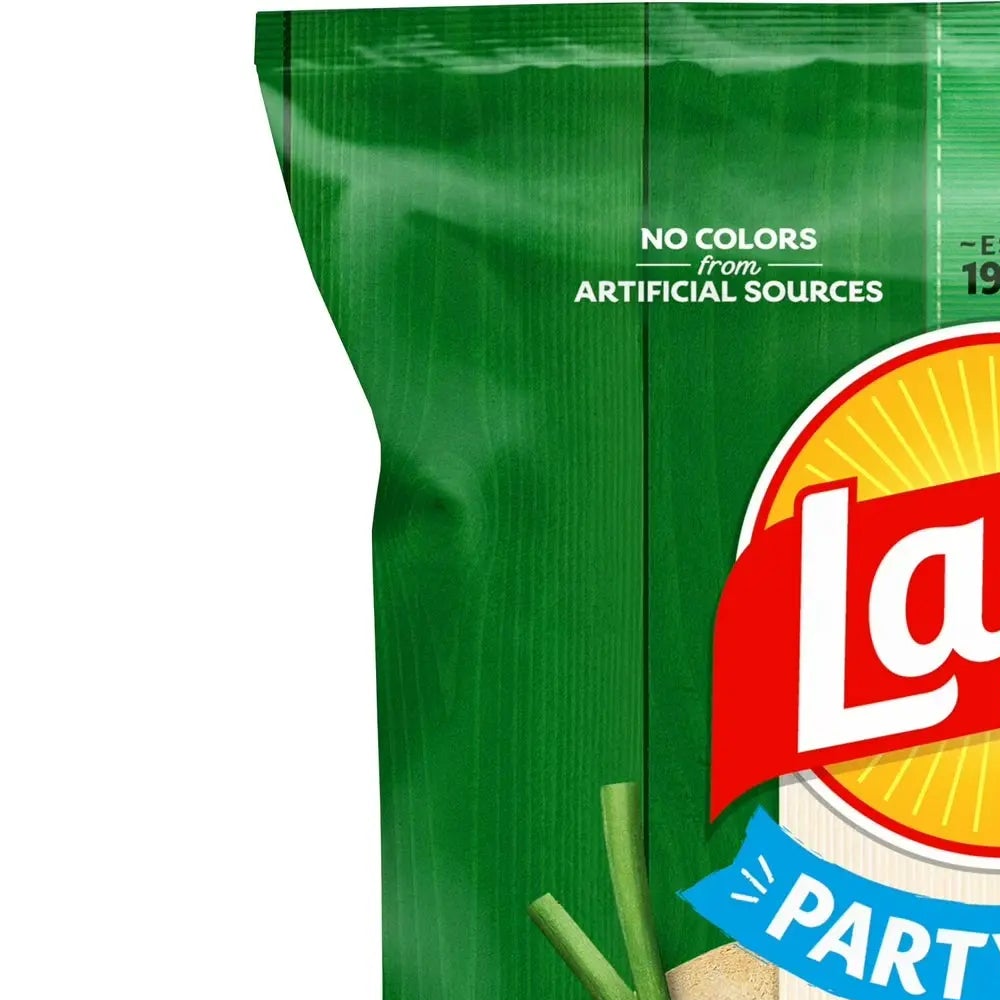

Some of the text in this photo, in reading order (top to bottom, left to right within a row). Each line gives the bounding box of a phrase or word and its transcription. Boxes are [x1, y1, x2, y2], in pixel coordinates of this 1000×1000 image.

[641, 226, 818, 251] NO COLORS
[698, 254, 763, 277] from
[574, 280, 884, 304] ARTIFICIAL SOURCES
